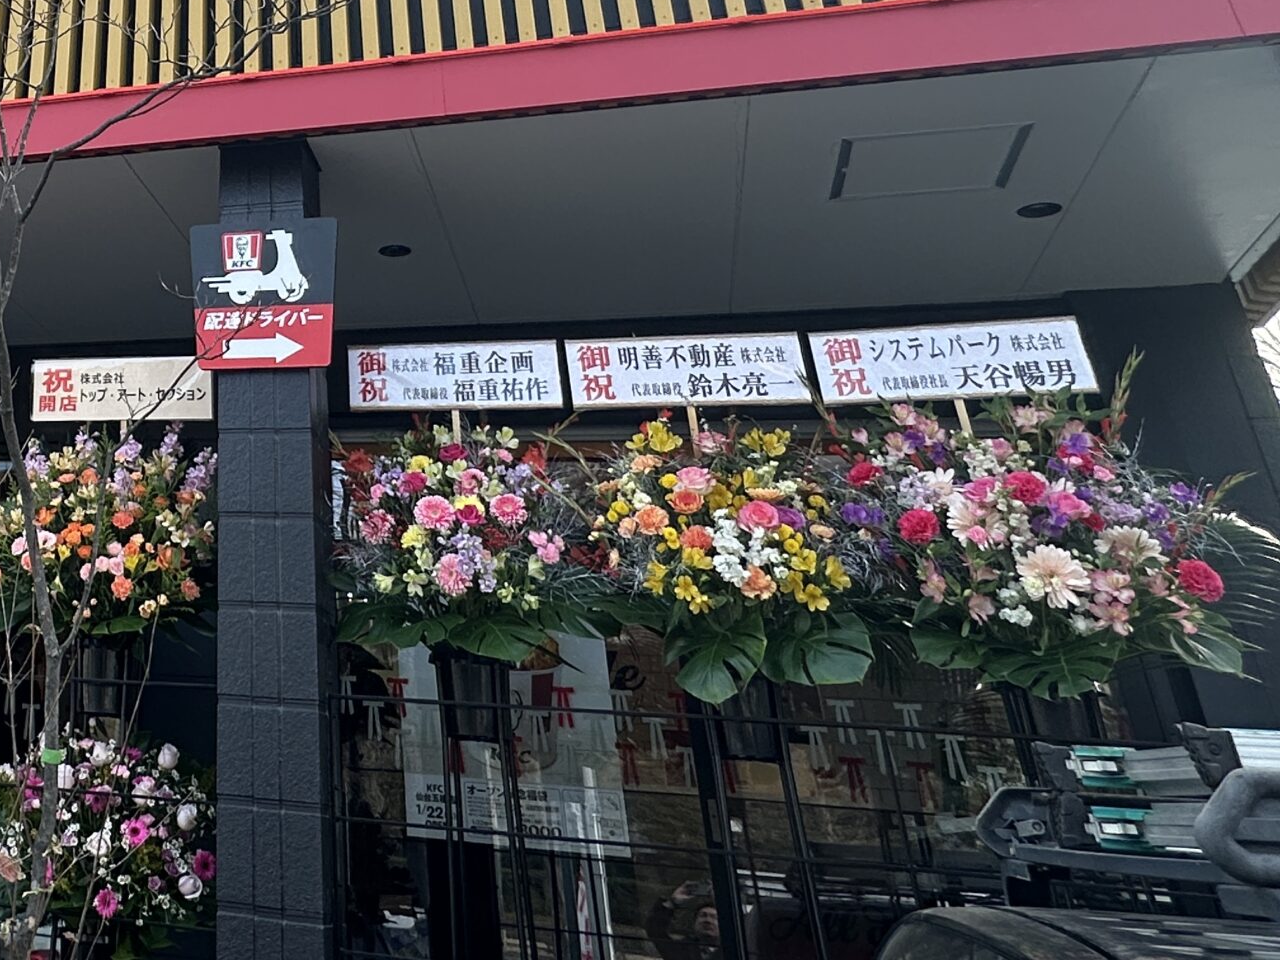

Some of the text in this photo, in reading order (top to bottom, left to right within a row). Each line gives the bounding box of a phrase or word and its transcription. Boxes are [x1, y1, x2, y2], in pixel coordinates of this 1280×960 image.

[231, 260, 254, 268] KFC
[617, 343, 787, 371] 明善不動産 株式会社
[868, 332, 1066, 362] システムパーク 株式会社
[392, 351, 534, 375] 株式会社 福重企画
[882, 359, 1077, 391] 代表取締役社長 天谷暢男
[42, 369, 74, 393] 祝
[80, 373, 124, 384] 株式会社
[453, 377, 549, 402] 福重祐作
[687, 372, 795, 398] 鈴木亮一
[39, 395, 77, 412] 開店
